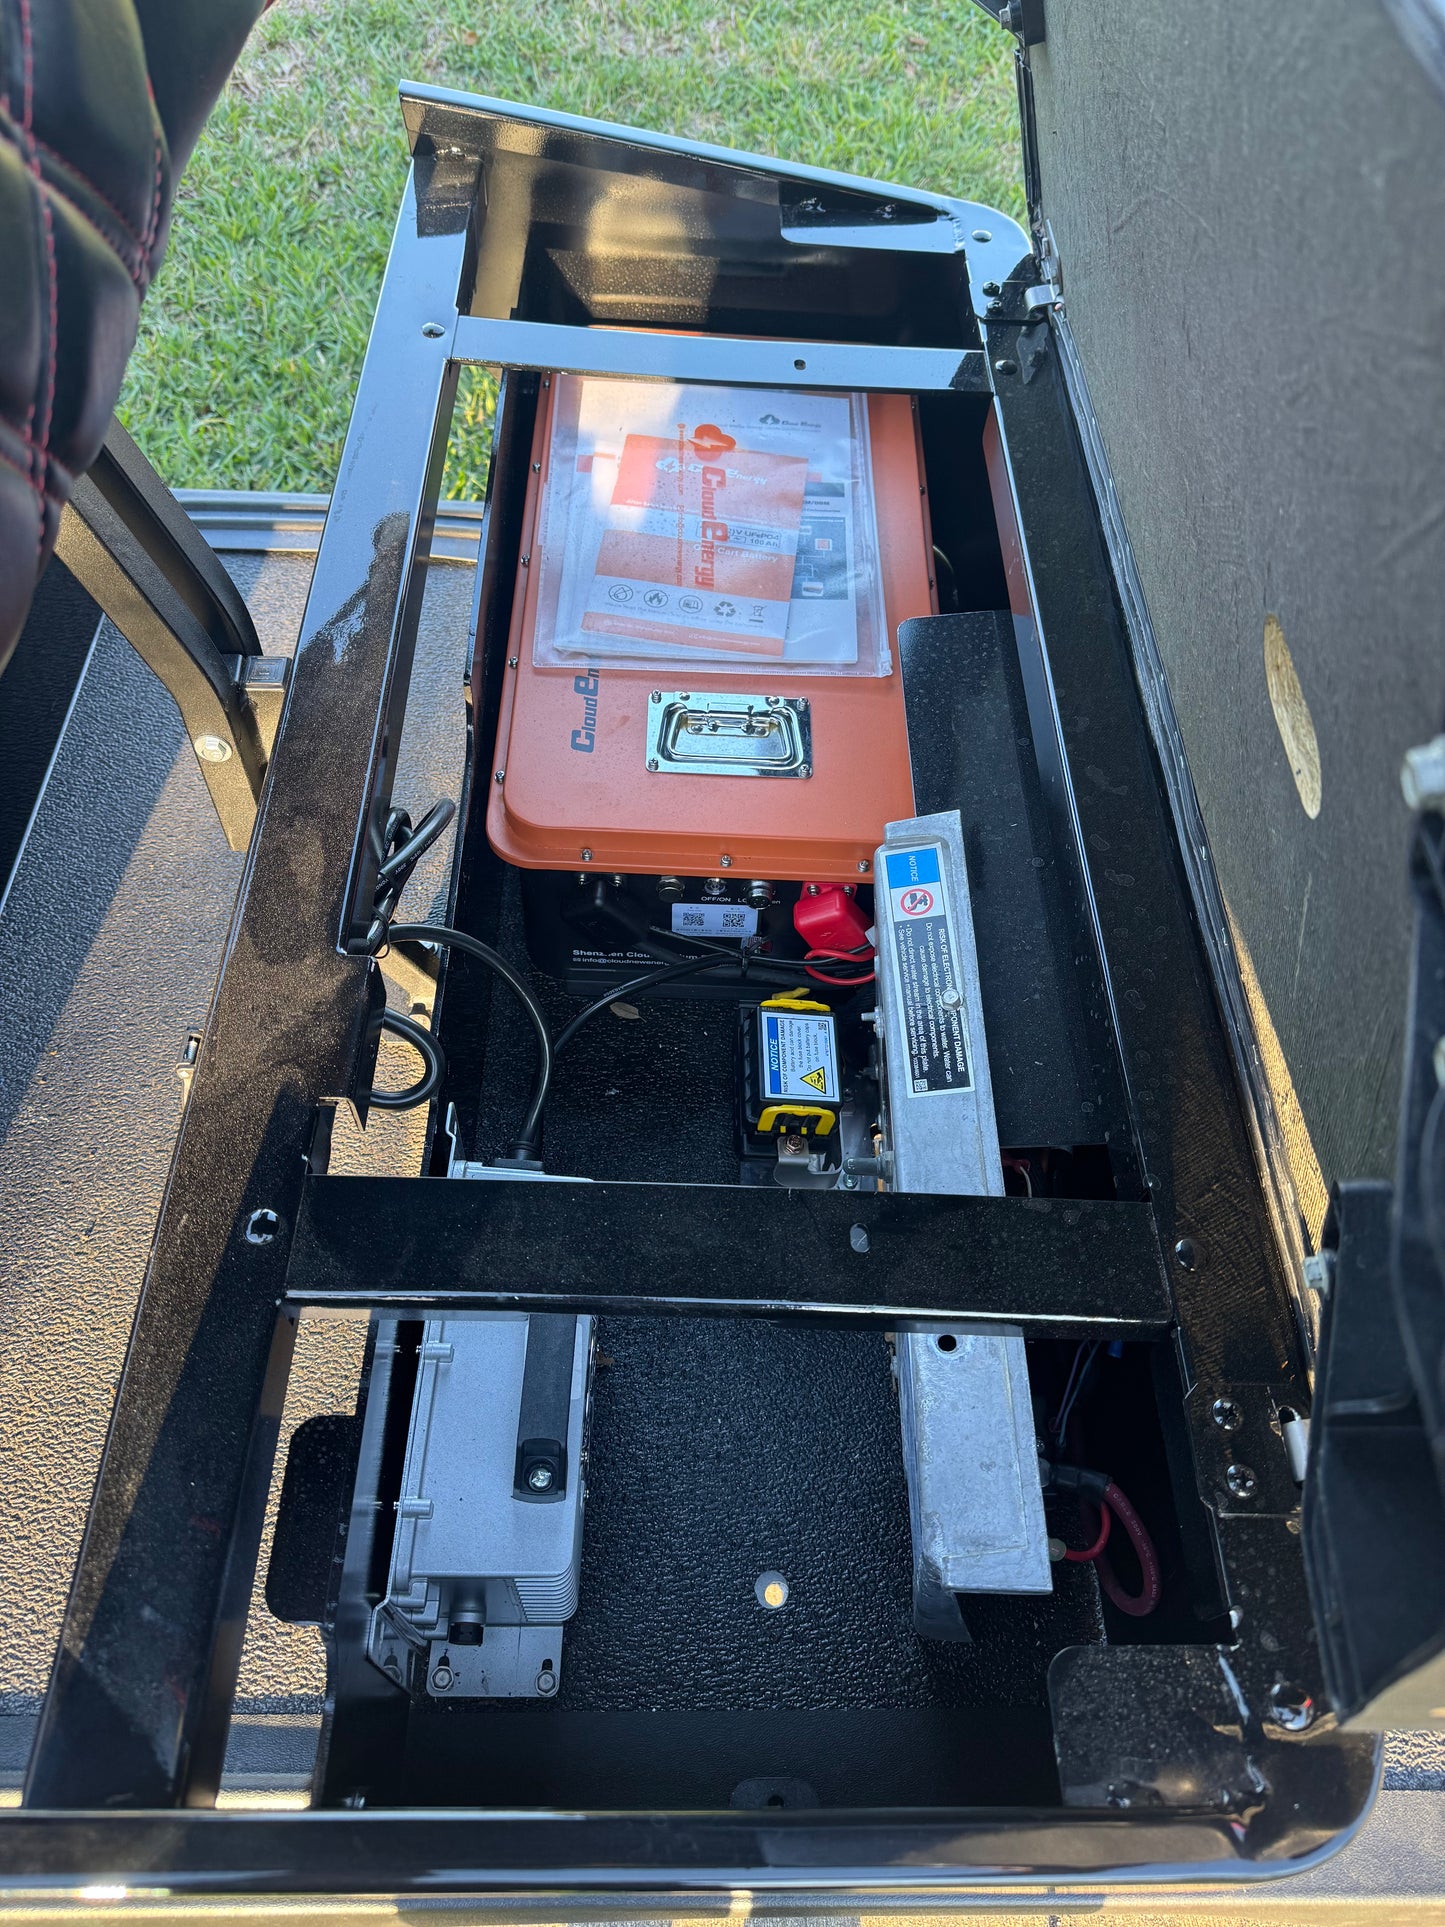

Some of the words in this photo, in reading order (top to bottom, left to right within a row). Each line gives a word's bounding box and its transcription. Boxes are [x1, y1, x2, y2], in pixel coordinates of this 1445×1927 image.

[694, 466, 727, 589] CloudEnergy
[908, 855, 918, 882] NOTICE
[701, 895, 731, 903] OFF/ON
[905, 927, 912, 936] Do
[925, 922, 932, 931] Do
[938, 928, 946, 943] RISK
[899, 941, 907, 961] vehicle
[907, 947, 915, 963] direct
[926, 941, 936, 962] expose
[940, 944, 948, 953] OF
[901, 962, 909, 982] service
[909, 964, 917, 980] water
[919, 963, 929, 986] damage
[930, 962, 940, 987] electrical
[942, 954, 953, 990] ELECTRON
[904, 983, 913, 1005] manual
[912, 981, 920, 1002] stream
[907, 1006, 916, 1026] before
[925, 994, 934, 1019] electrical
[949, 1010, 960, 1040] PONENT
[908, 1027, 919, 1055] servicing.
[919, 1042, 927, 1054] this
[927, 1020, 940, 1058] components.
[940, 1032, 949, 1050] water.
[770, 1038, 778, 1070] NOTICE
[918, 1054, 930, 1072] plate.
[942, 1050, 951, 1069] Water
[953, 1041, 964, 1072] DAMAGE
